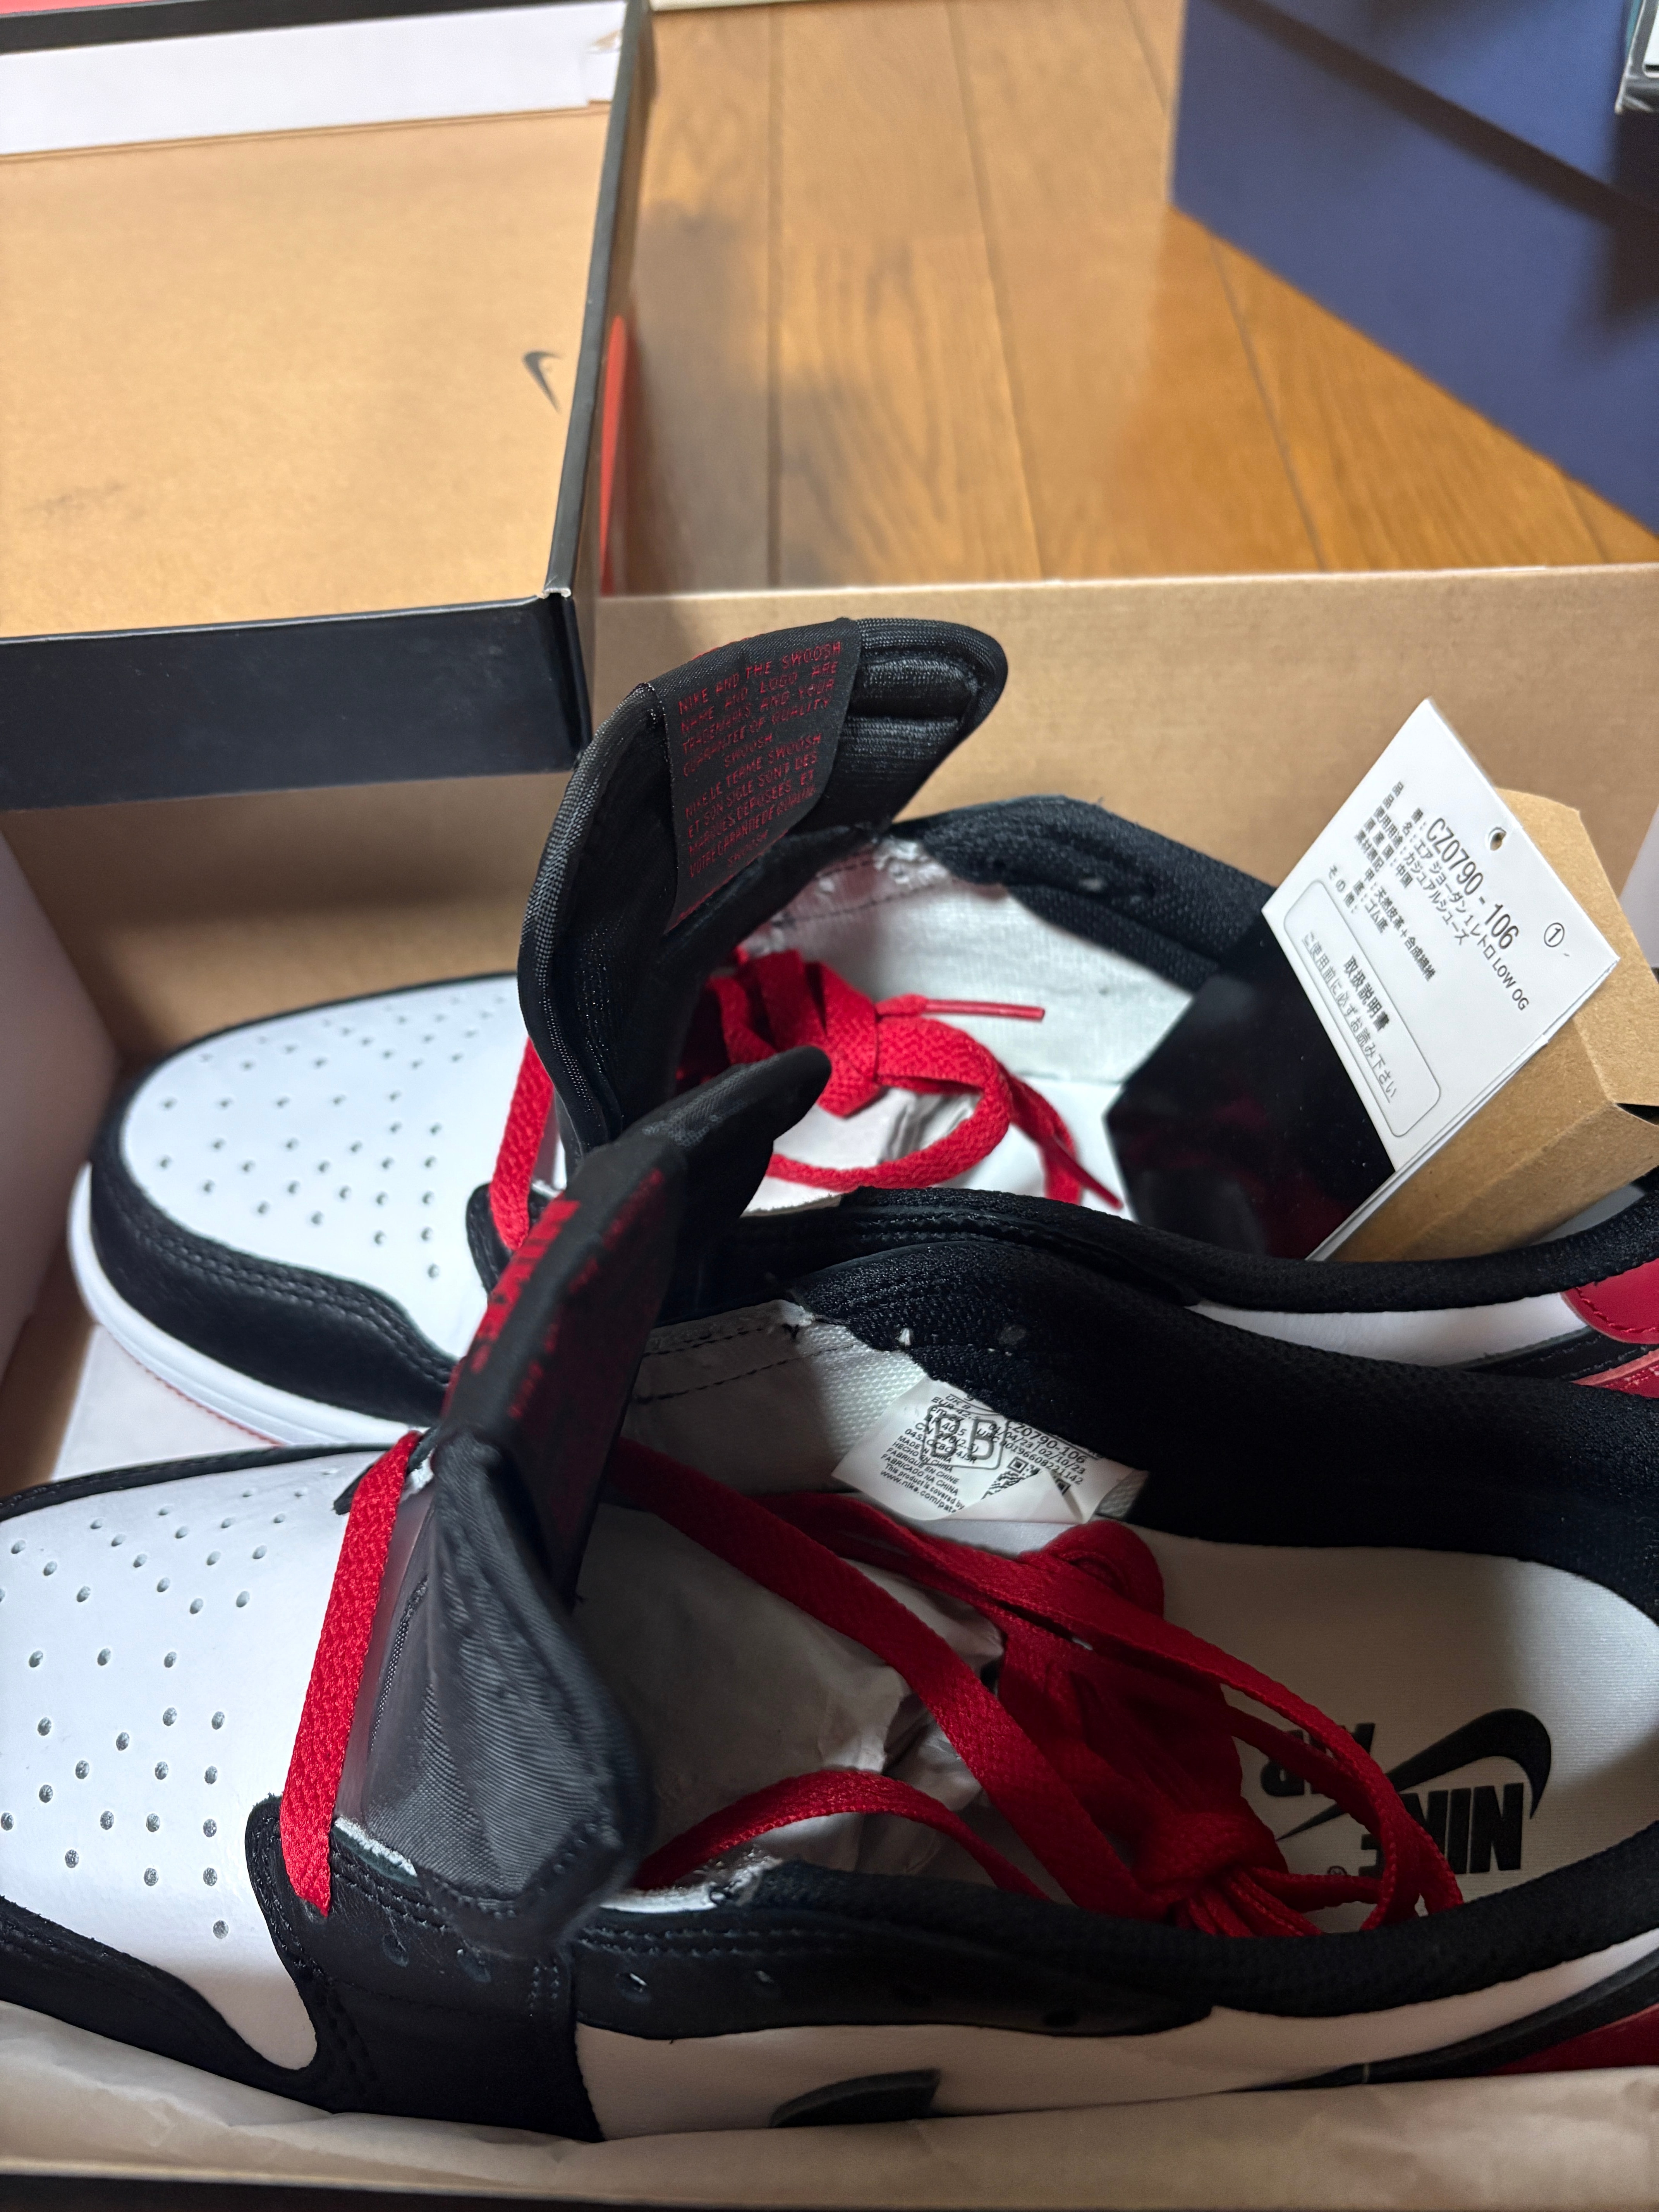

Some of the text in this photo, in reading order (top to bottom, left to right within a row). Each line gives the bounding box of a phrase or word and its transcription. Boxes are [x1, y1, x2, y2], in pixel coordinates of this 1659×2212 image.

[678, 641, 842, 715] NIKE AND THE SWOOSH
[725, 687, 748, 709] AND
[760, 672, 798, 694] LOGO
[811, 661, 839, 678] ARE
[760, 690, 790, 712] AND
[799, 679, 835, 699] YOUR
[749, 717, 765, 733] OF
[771, 697, 831, 725] QUALITY
[724, 733, 773, 768] SWOOSH
[726, 757, 763, 788] TERME
[768, 733, 821, 764] SWOOSH
[688, 819, 699, 838] ET
[758, 762, 789, 787] SONT
[795, 751, 818, 770] DES
[800, 769, 814, 785] ET
[1343, 955, 1389, 1032] 取扱説明書
[1492, 958, 1515, 990] LOW
[1511, 987, 1528, 1011] OG
[1304, 931, 1397, 1098] ご使用前に必ずお読み下さい
[931, 1396, 954, 1409] EUR
[931, 1406, 947, 1416] cm
[946, 1395, 962, 1405] UK
[897, 1435, 921, 1449] MADE
[915, 1422, 934, 1434] CN
[977, 1429, 1000, 1443] UPC
[1006, 1420, 1087, 1463] CZ0790-106
[881, 1454, 958, 1495] FABRICADO NA CHINA
[886, 1448, 924, 1468] FABRIQUE
[936, 1471, 959, 1484] CHINE
[892, 1441, 919, 1456] HECHO
[931, 1460, 953, 1472] CHINA
[1039, 1448, 1085, 1474] 02/10/23
[885, 1463, 898, 1473] This
[898, 1471, 924, 1486] product
[930, 1487, 957, 1504] covered
[955, 1499, 965, 1510] by
